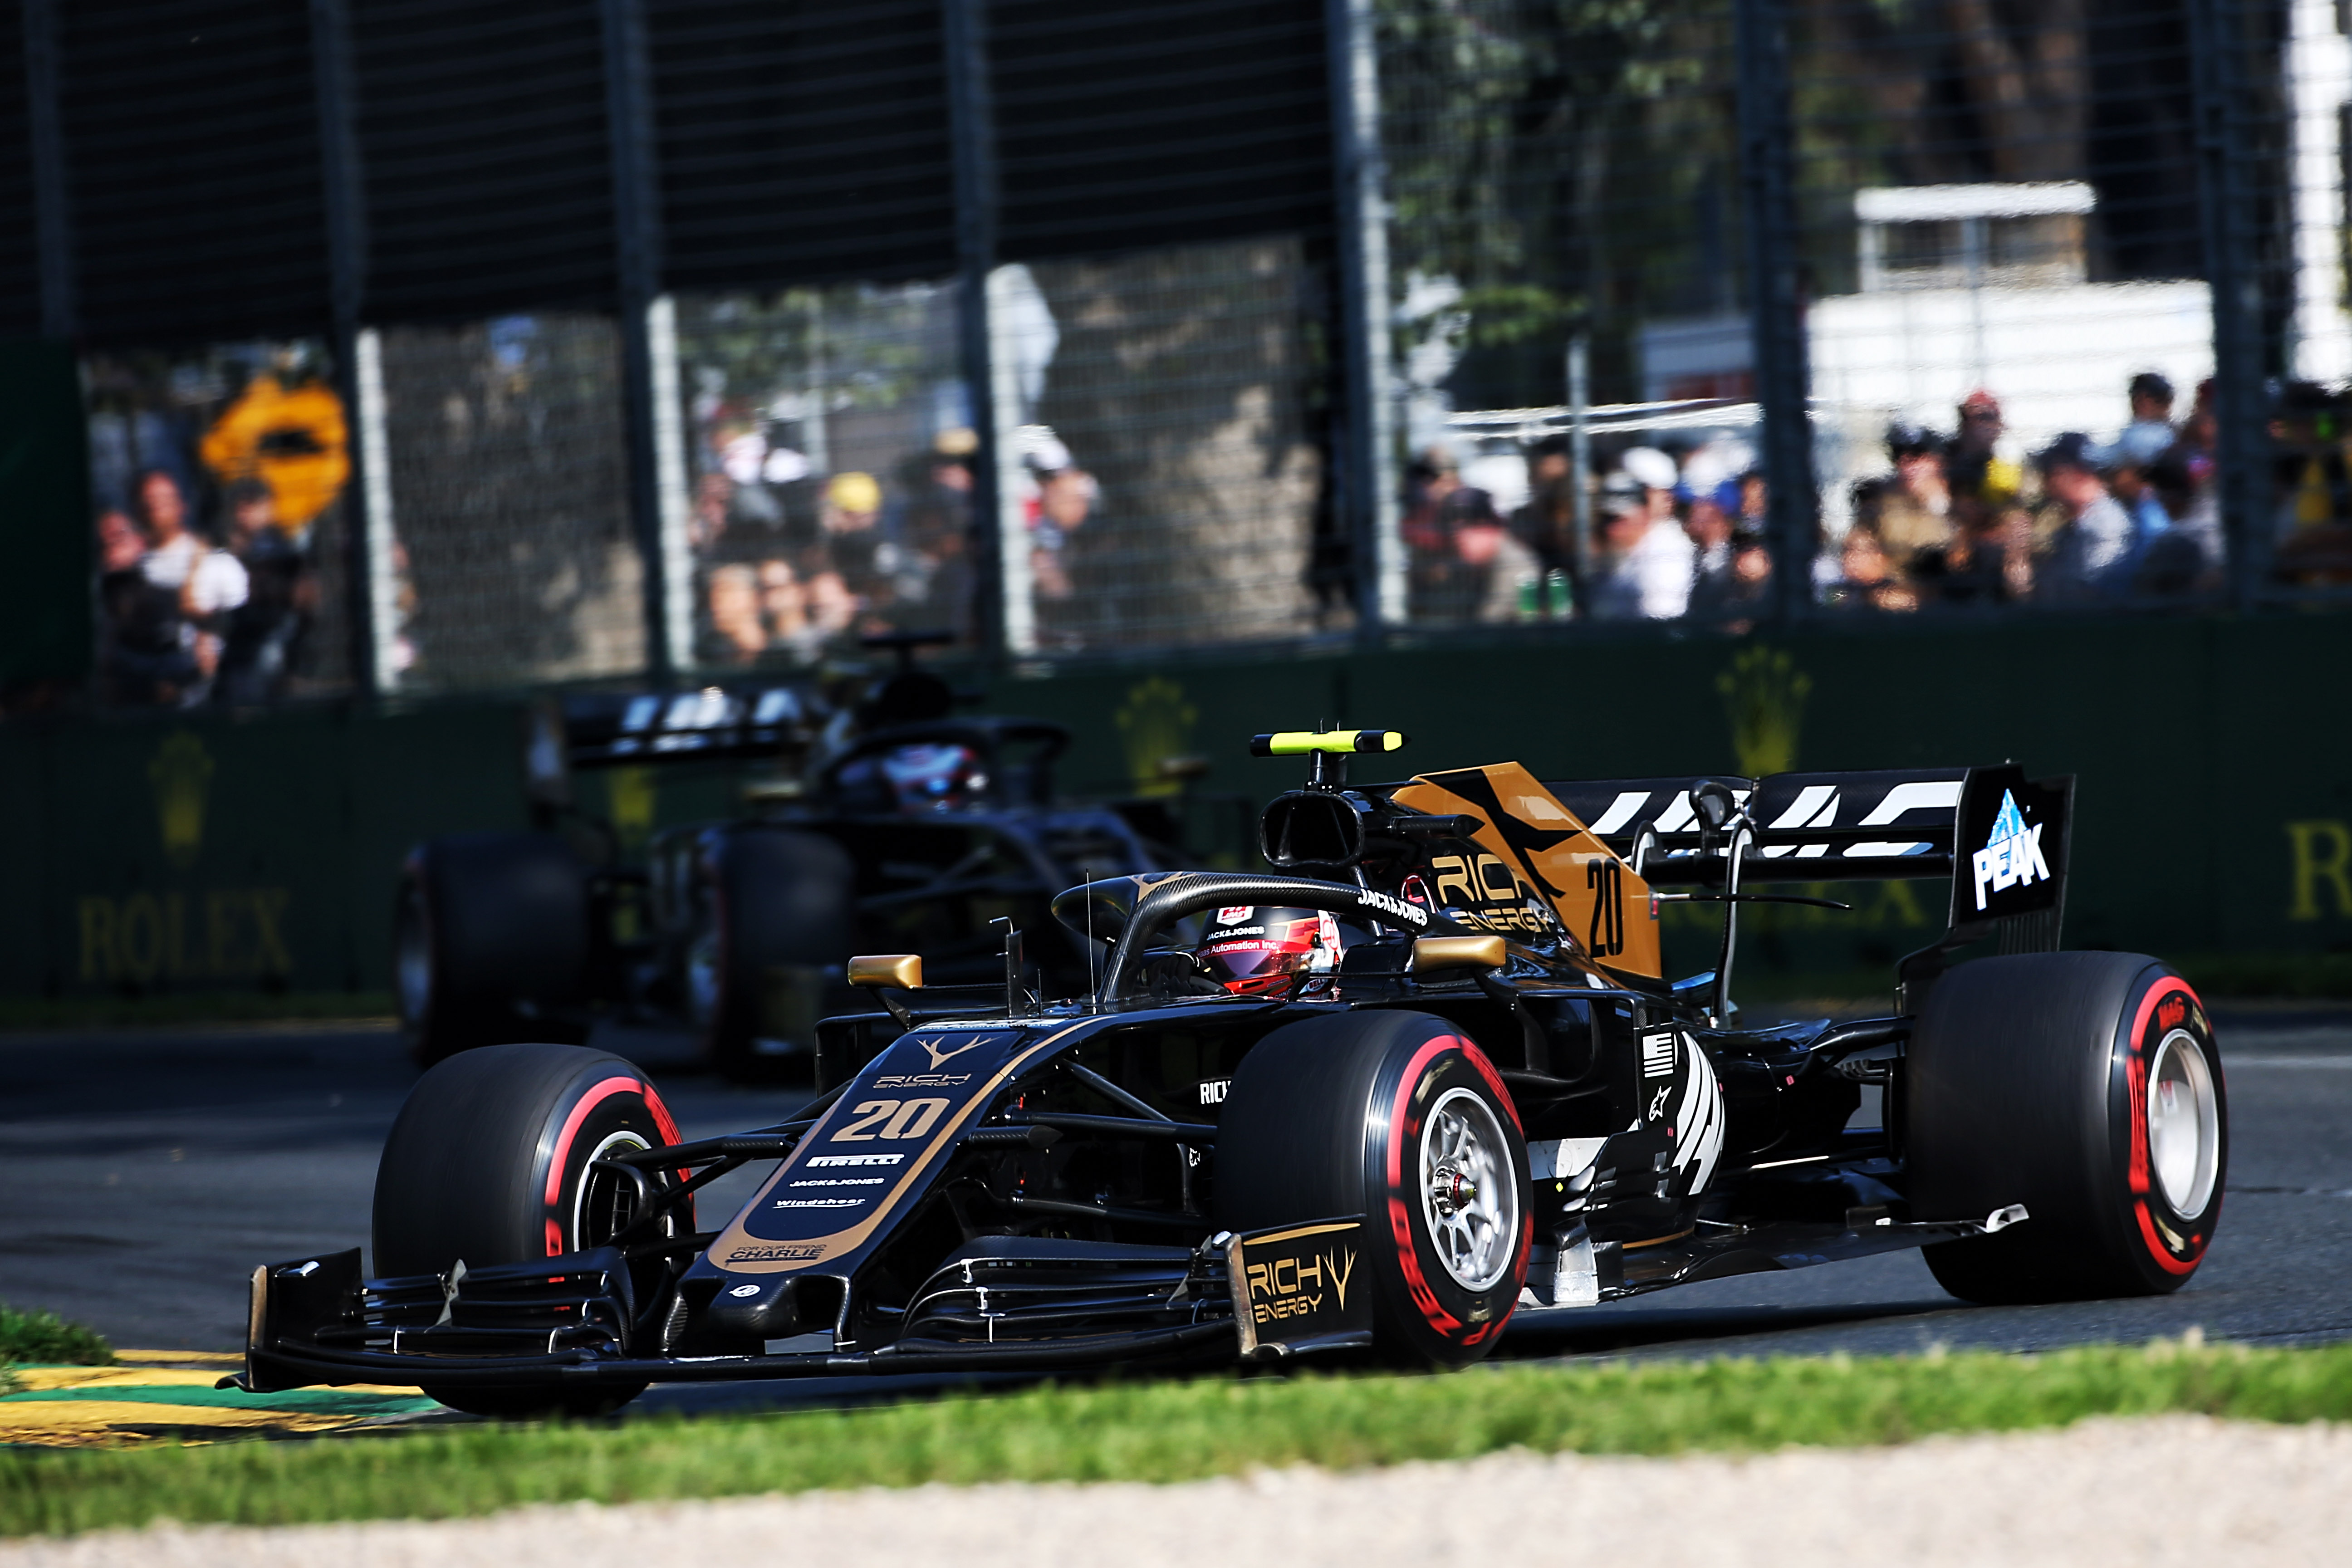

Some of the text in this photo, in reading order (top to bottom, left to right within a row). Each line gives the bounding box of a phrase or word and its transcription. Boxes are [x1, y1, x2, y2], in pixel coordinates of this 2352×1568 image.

[1972, 823, 2050, 911] PEAK
[1357, 888, 1428, 926] JACK&JONES
[1587, 857, 1623, 958] 20
[77, 887, 293, 982] ROLEX
[1206, 926, 1265, 941] JACK&JONES
[1210, 941, 1260, 954] Automation
[1262, 941, 1279, 950] Inc.
[876, 1073, 972, 1083] RICH
[830, 1098, 951, 1142] 20
[806, 1154, 905, 1167] PIRELLI
[789, 1178, 885, 1187] JACK&JONES
[730, 1249, 825, 1259] CHARLIE
[1247, 1254, 1322, 1299] RICH
[1254, 1293, 1322, 1323] ENERGY
